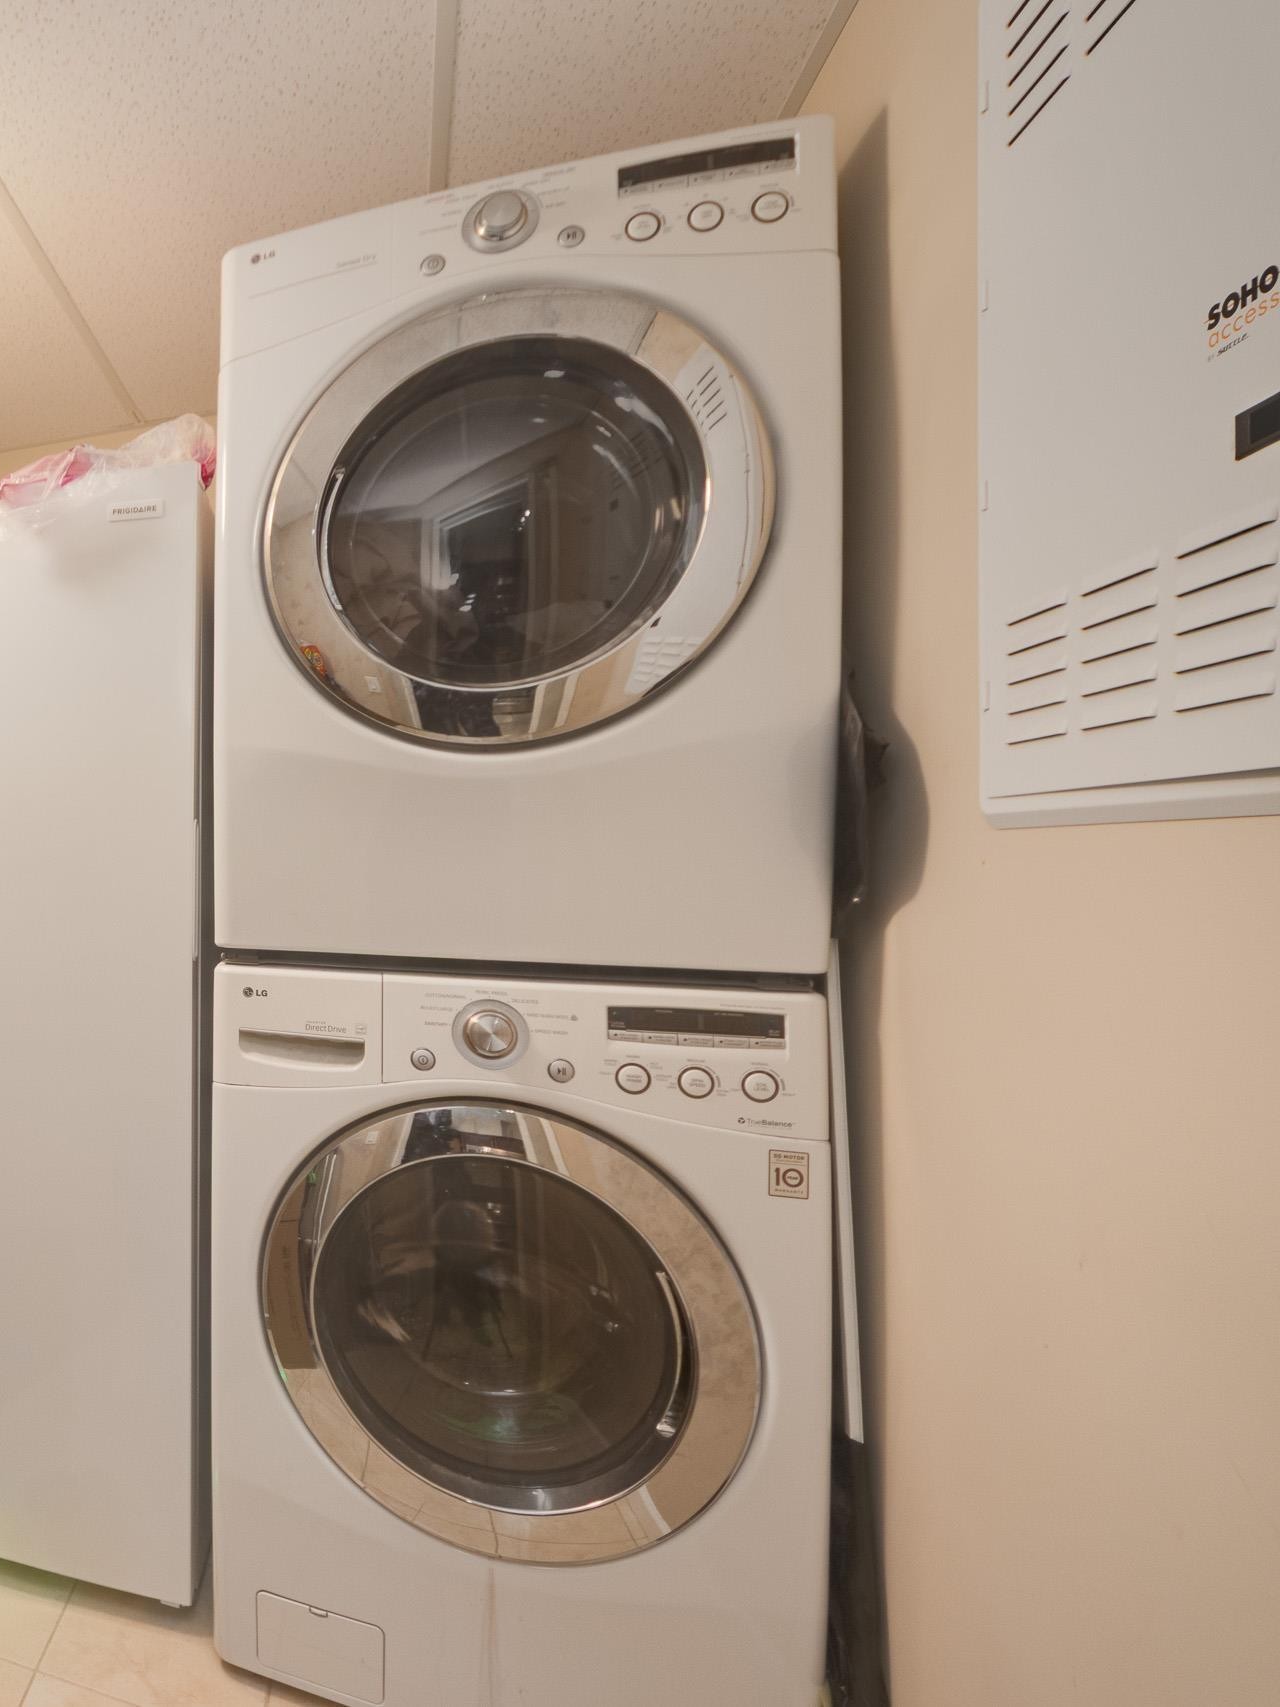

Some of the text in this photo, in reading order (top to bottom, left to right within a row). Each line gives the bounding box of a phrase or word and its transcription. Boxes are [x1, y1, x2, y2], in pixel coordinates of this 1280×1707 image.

[1207, 265, 1279, 331] SOHO
[1208, 291, 1280, 348] access
[112, 504, 158, 516] FRIGIDAIRE
[256, 989, 268, 997] LG
[774, 1167, 804, 1188] 10
